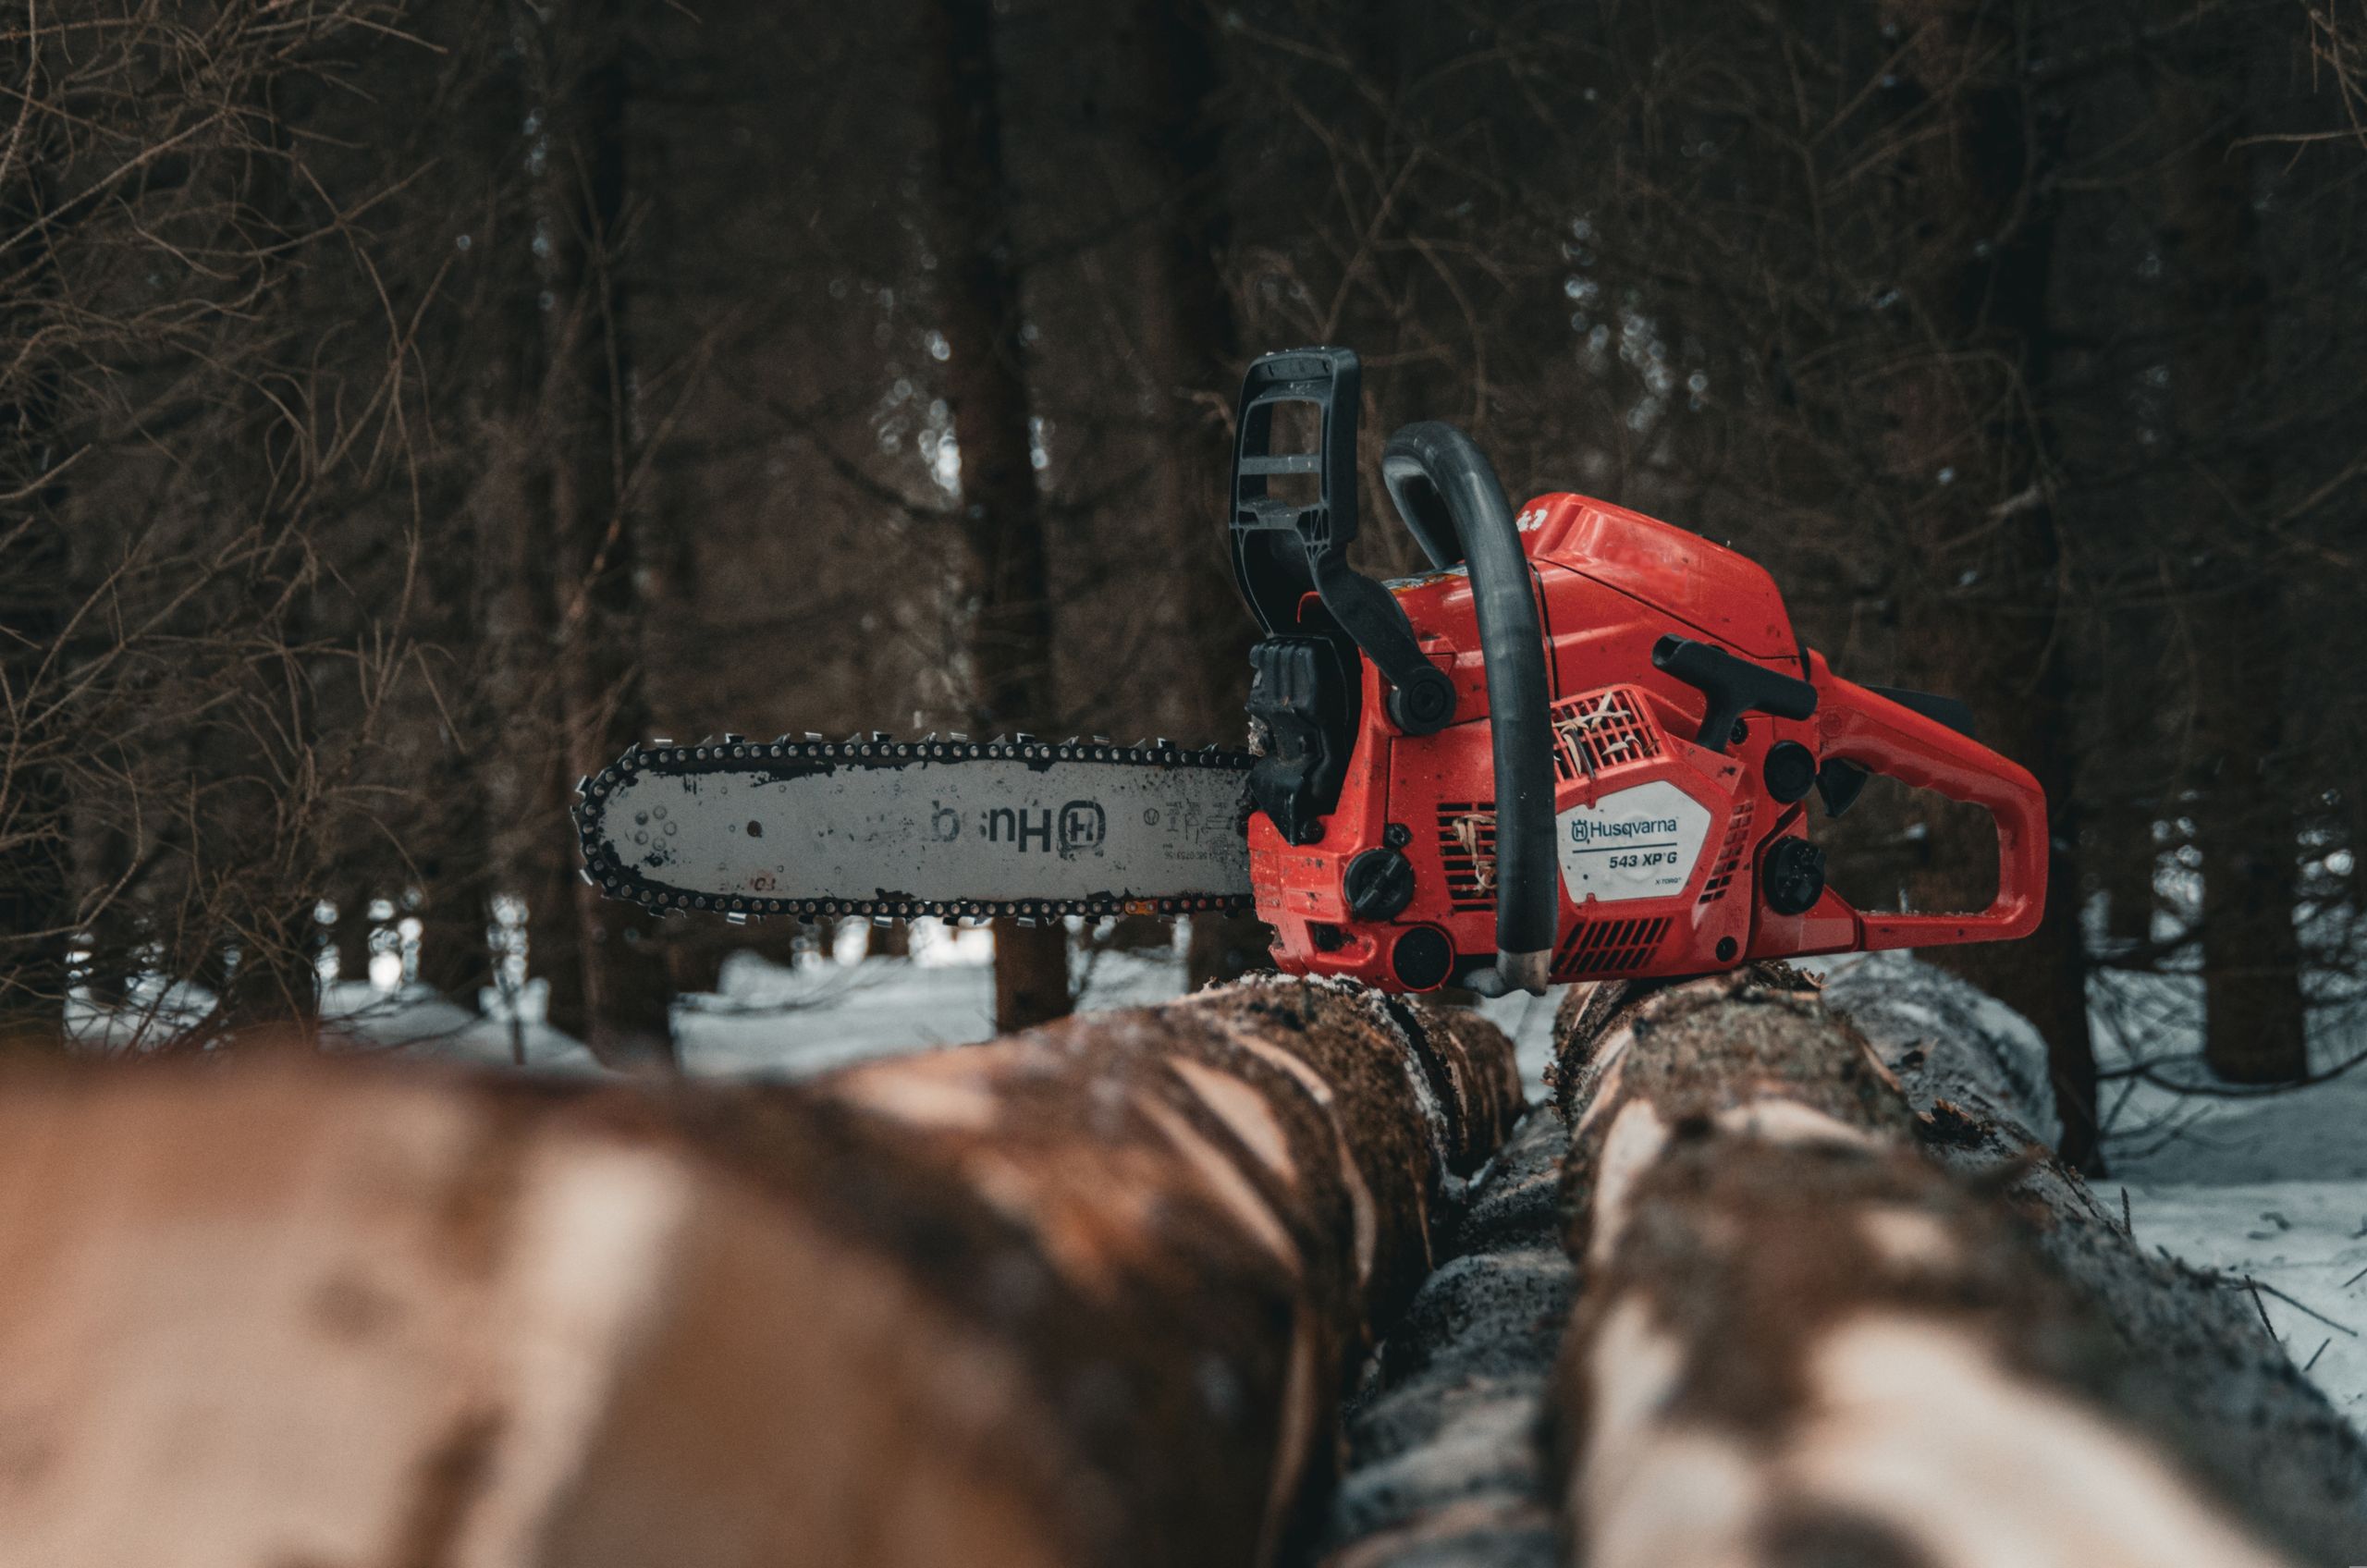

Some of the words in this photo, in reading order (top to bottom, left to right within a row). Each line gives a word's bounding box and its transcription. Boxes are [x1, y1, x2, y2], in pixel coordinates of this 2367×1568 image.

[1590, 819, 1676, 838] Husqvarna
[1609, 855, 1637, 869] 543
[1667, 851, 1677, 864] G
